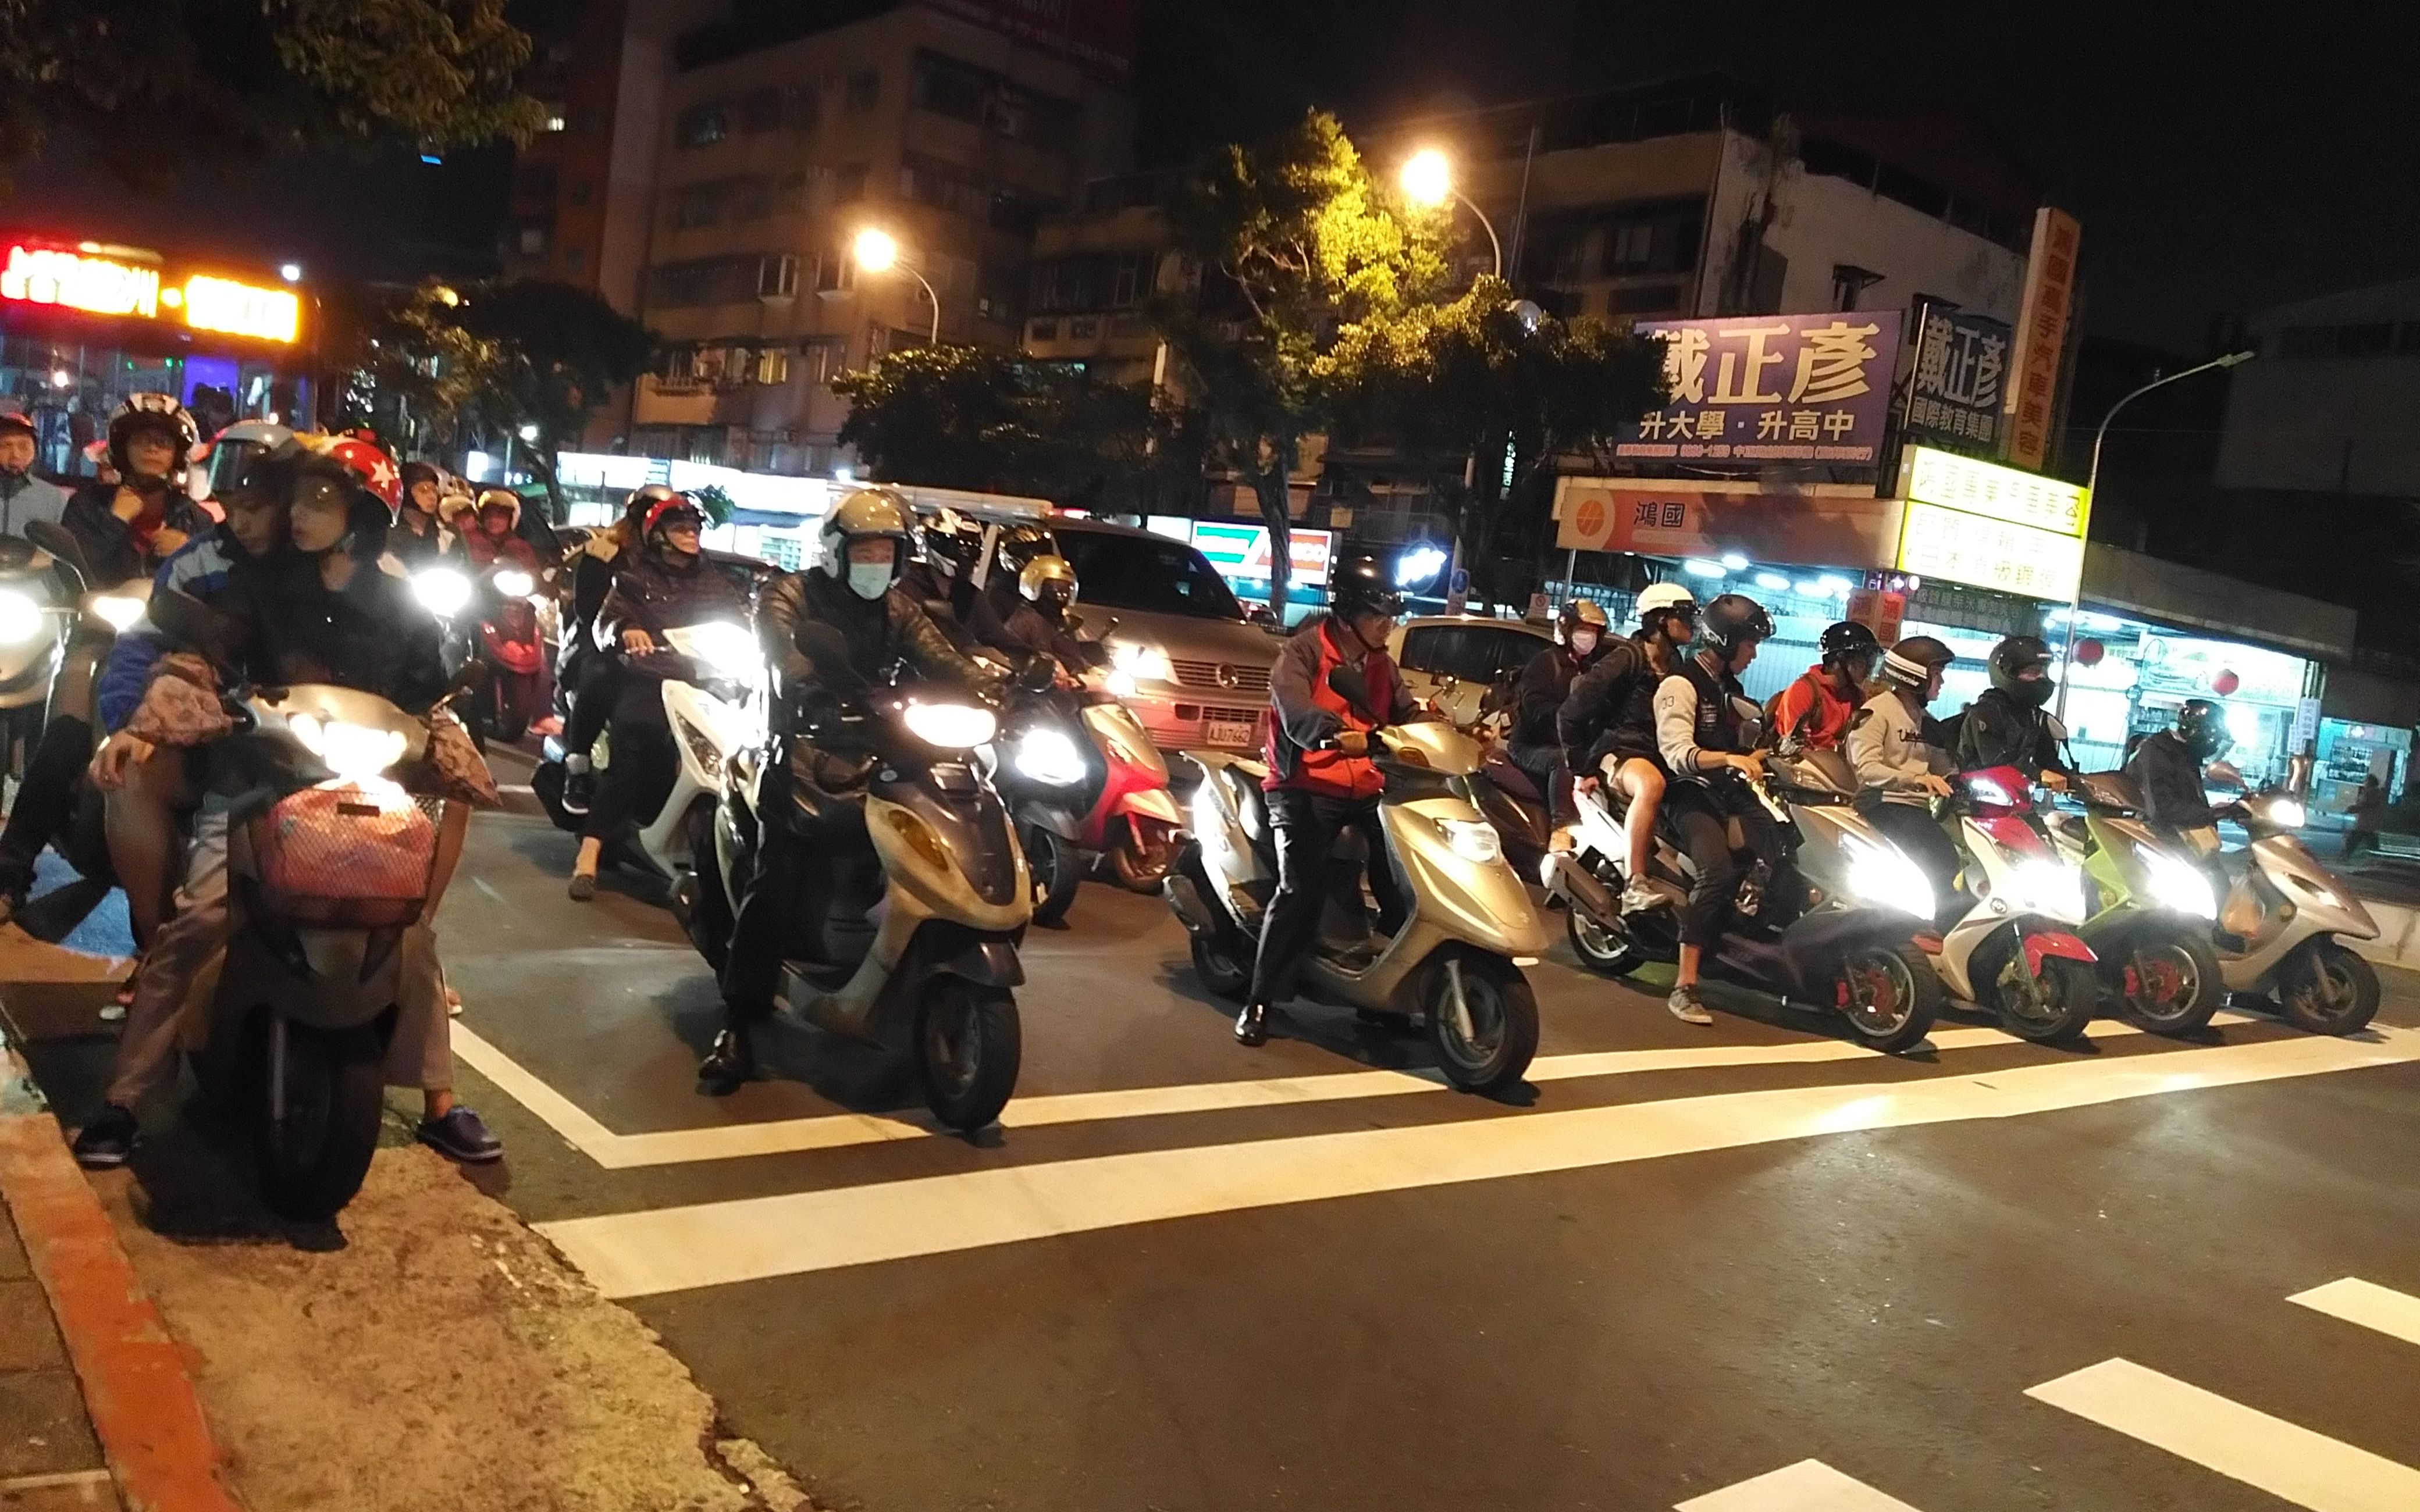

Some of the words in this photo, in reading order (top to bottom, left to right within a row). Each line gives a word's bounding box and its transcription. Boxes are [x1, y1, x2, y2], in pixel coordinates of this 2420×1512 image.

[1917, 315, 2006, 408] 戴正彥
[1911, 397, 1994, 443] 國際教育集團
[1634, 502, 1685, 527] 鴻國
